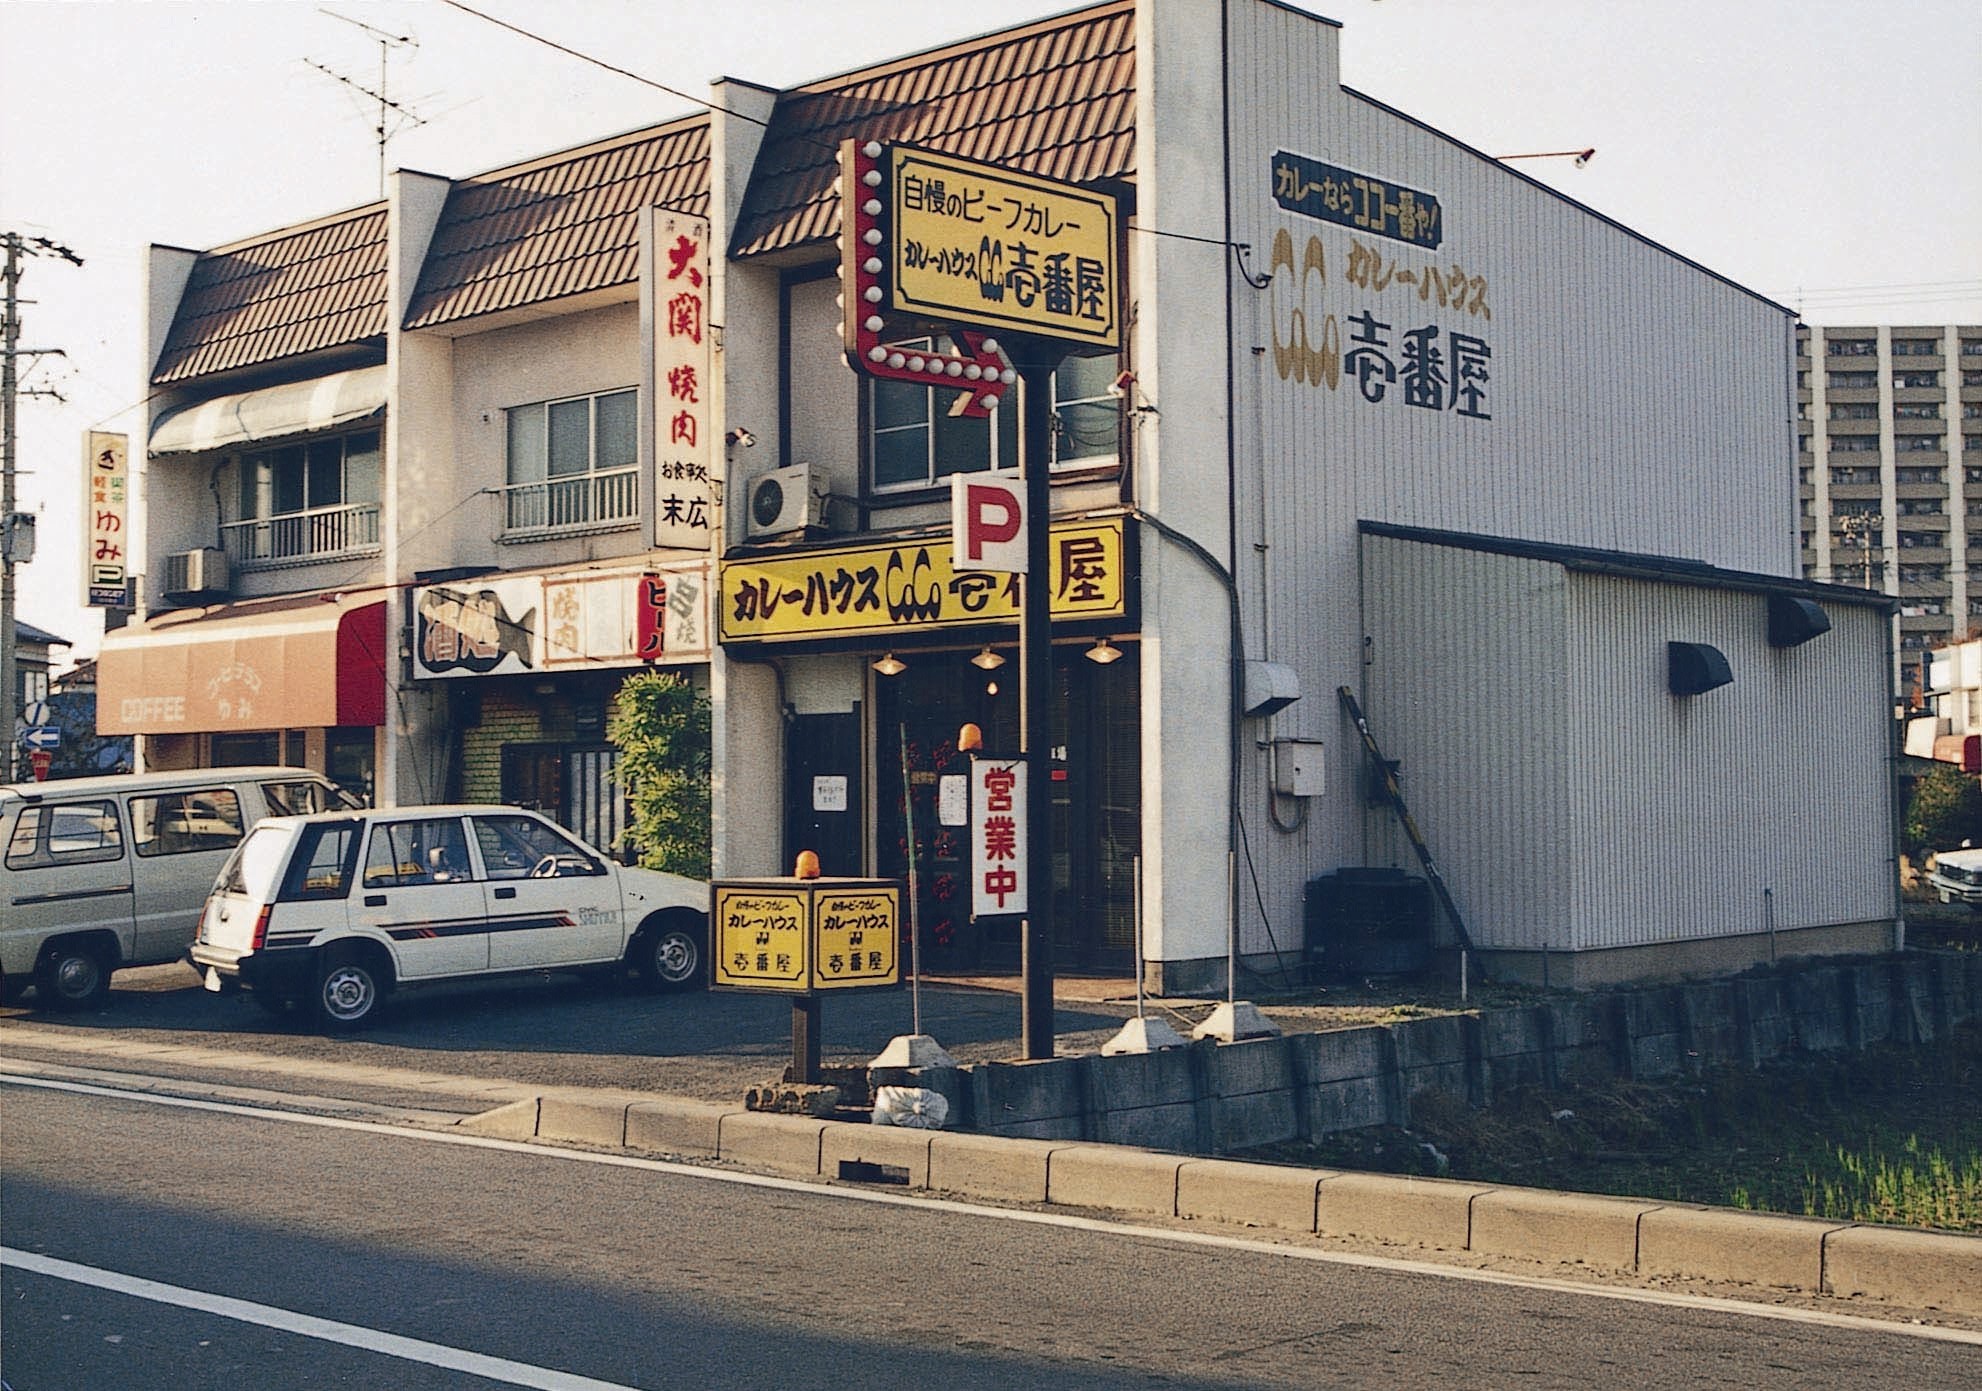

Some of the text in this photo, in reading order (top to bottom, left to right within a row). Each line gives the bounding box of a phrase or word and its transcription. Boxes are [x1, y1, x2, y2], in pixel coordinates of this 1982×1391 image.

[904, 174, 1080, 238] 自慢のビーフカレー
[667, 234, 704, 346] 大関
[1345, 238, 1491, 322] カレーハウス
[1344, 309, 1492, 421] 壱番屋
[667, 363, 700, 448] 焼肉
[95, 510, 122, 560] ゆみ
[661, 493, 708, 530] 末広
[966, 484, 1022, 561] P
[120, 696, 186, 722] COFFEE
[984, 767, 1017, 908] 営業中
[728, 914, 798, 930] カレーハウス
[824, 914, 889, 930] カレーハウス
[734, 952, 791, 972] 壱番屋
[829, 952, 883, 973] 壱番屋
